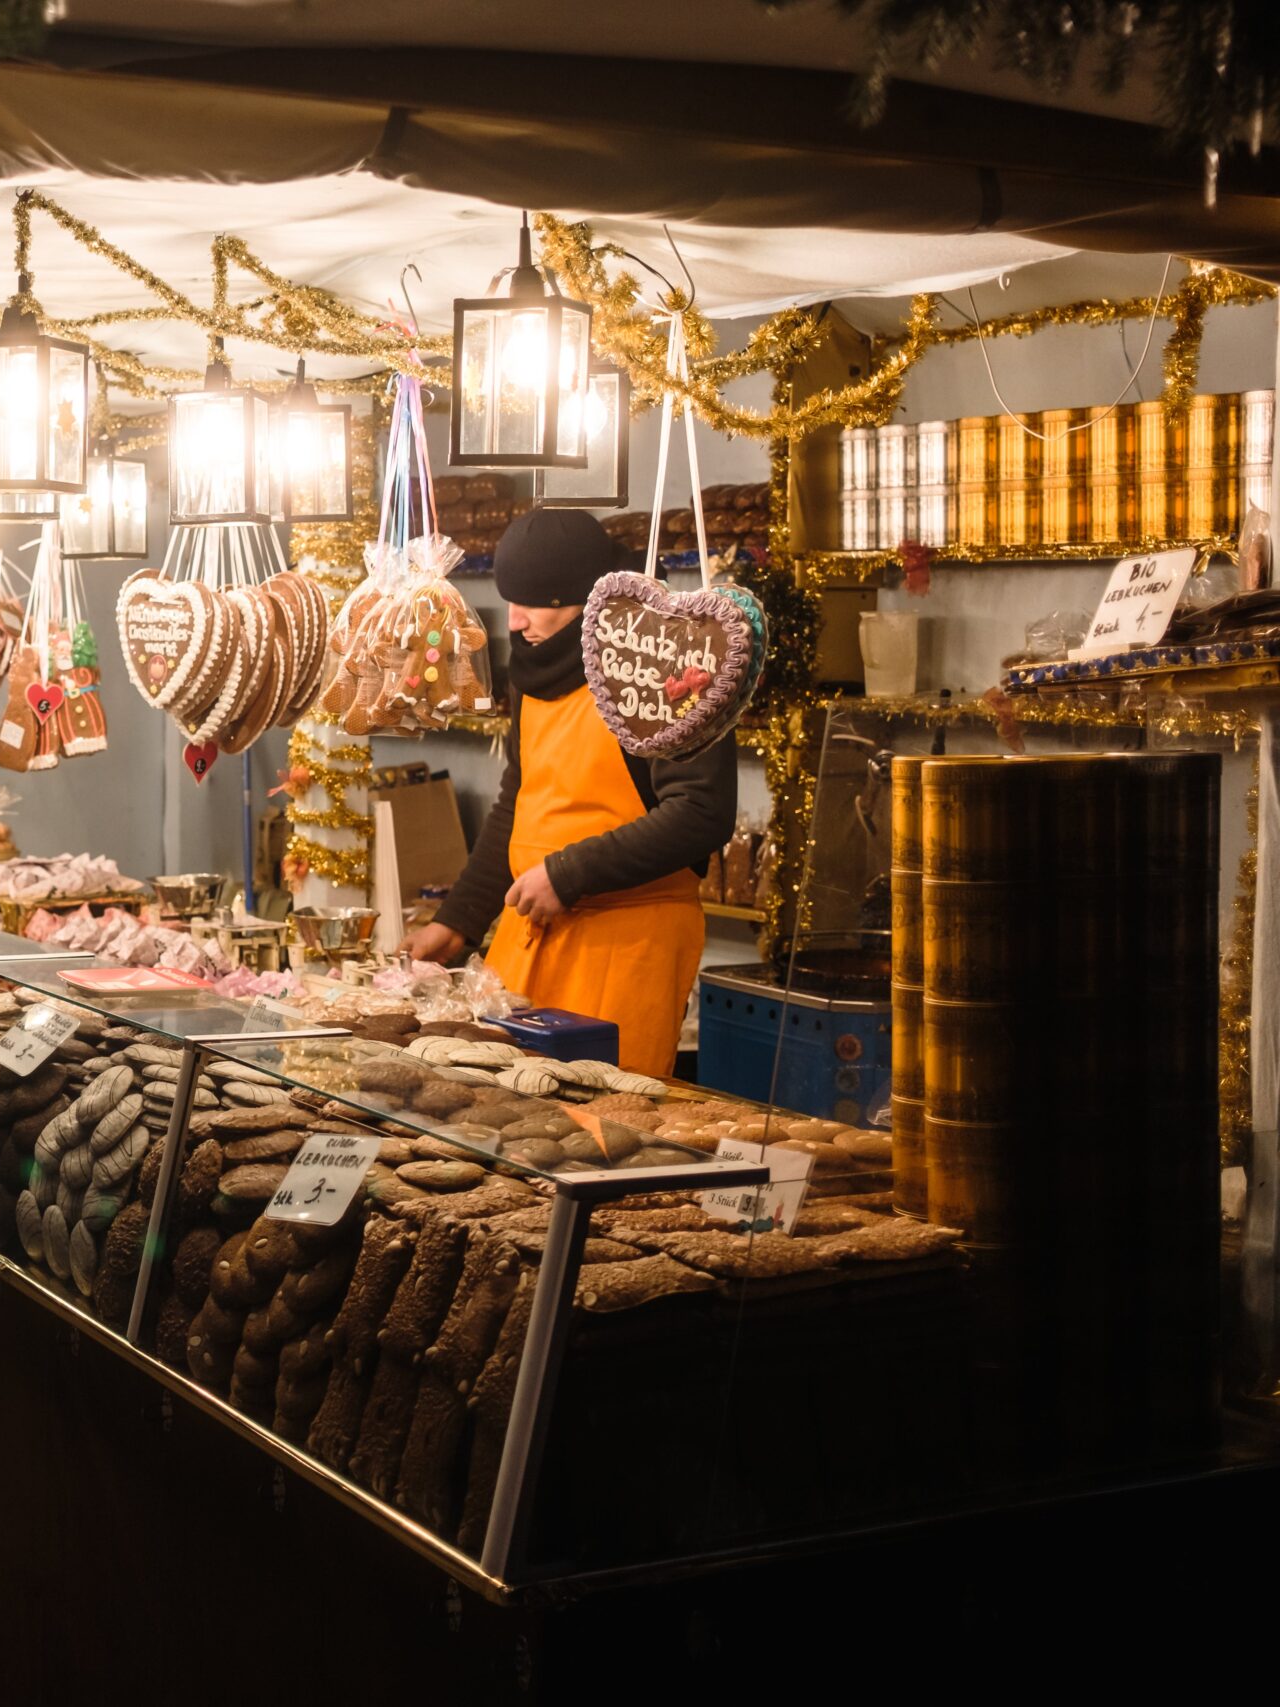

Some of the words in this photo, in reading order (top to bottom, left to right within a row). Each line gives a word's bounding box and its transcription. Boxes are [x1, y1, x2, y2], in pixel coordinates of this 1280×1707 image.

[1104, 580, 1172, 603] LEBKUCHEN
[144, 641, 178, 657] markt
[684, 636, 717, 674] ich
[617, 687, 678, 723] Dich
[295, 1153, 366, 1169] LEBKUCHEN
[716, 1193, 739, 1208] Stück
